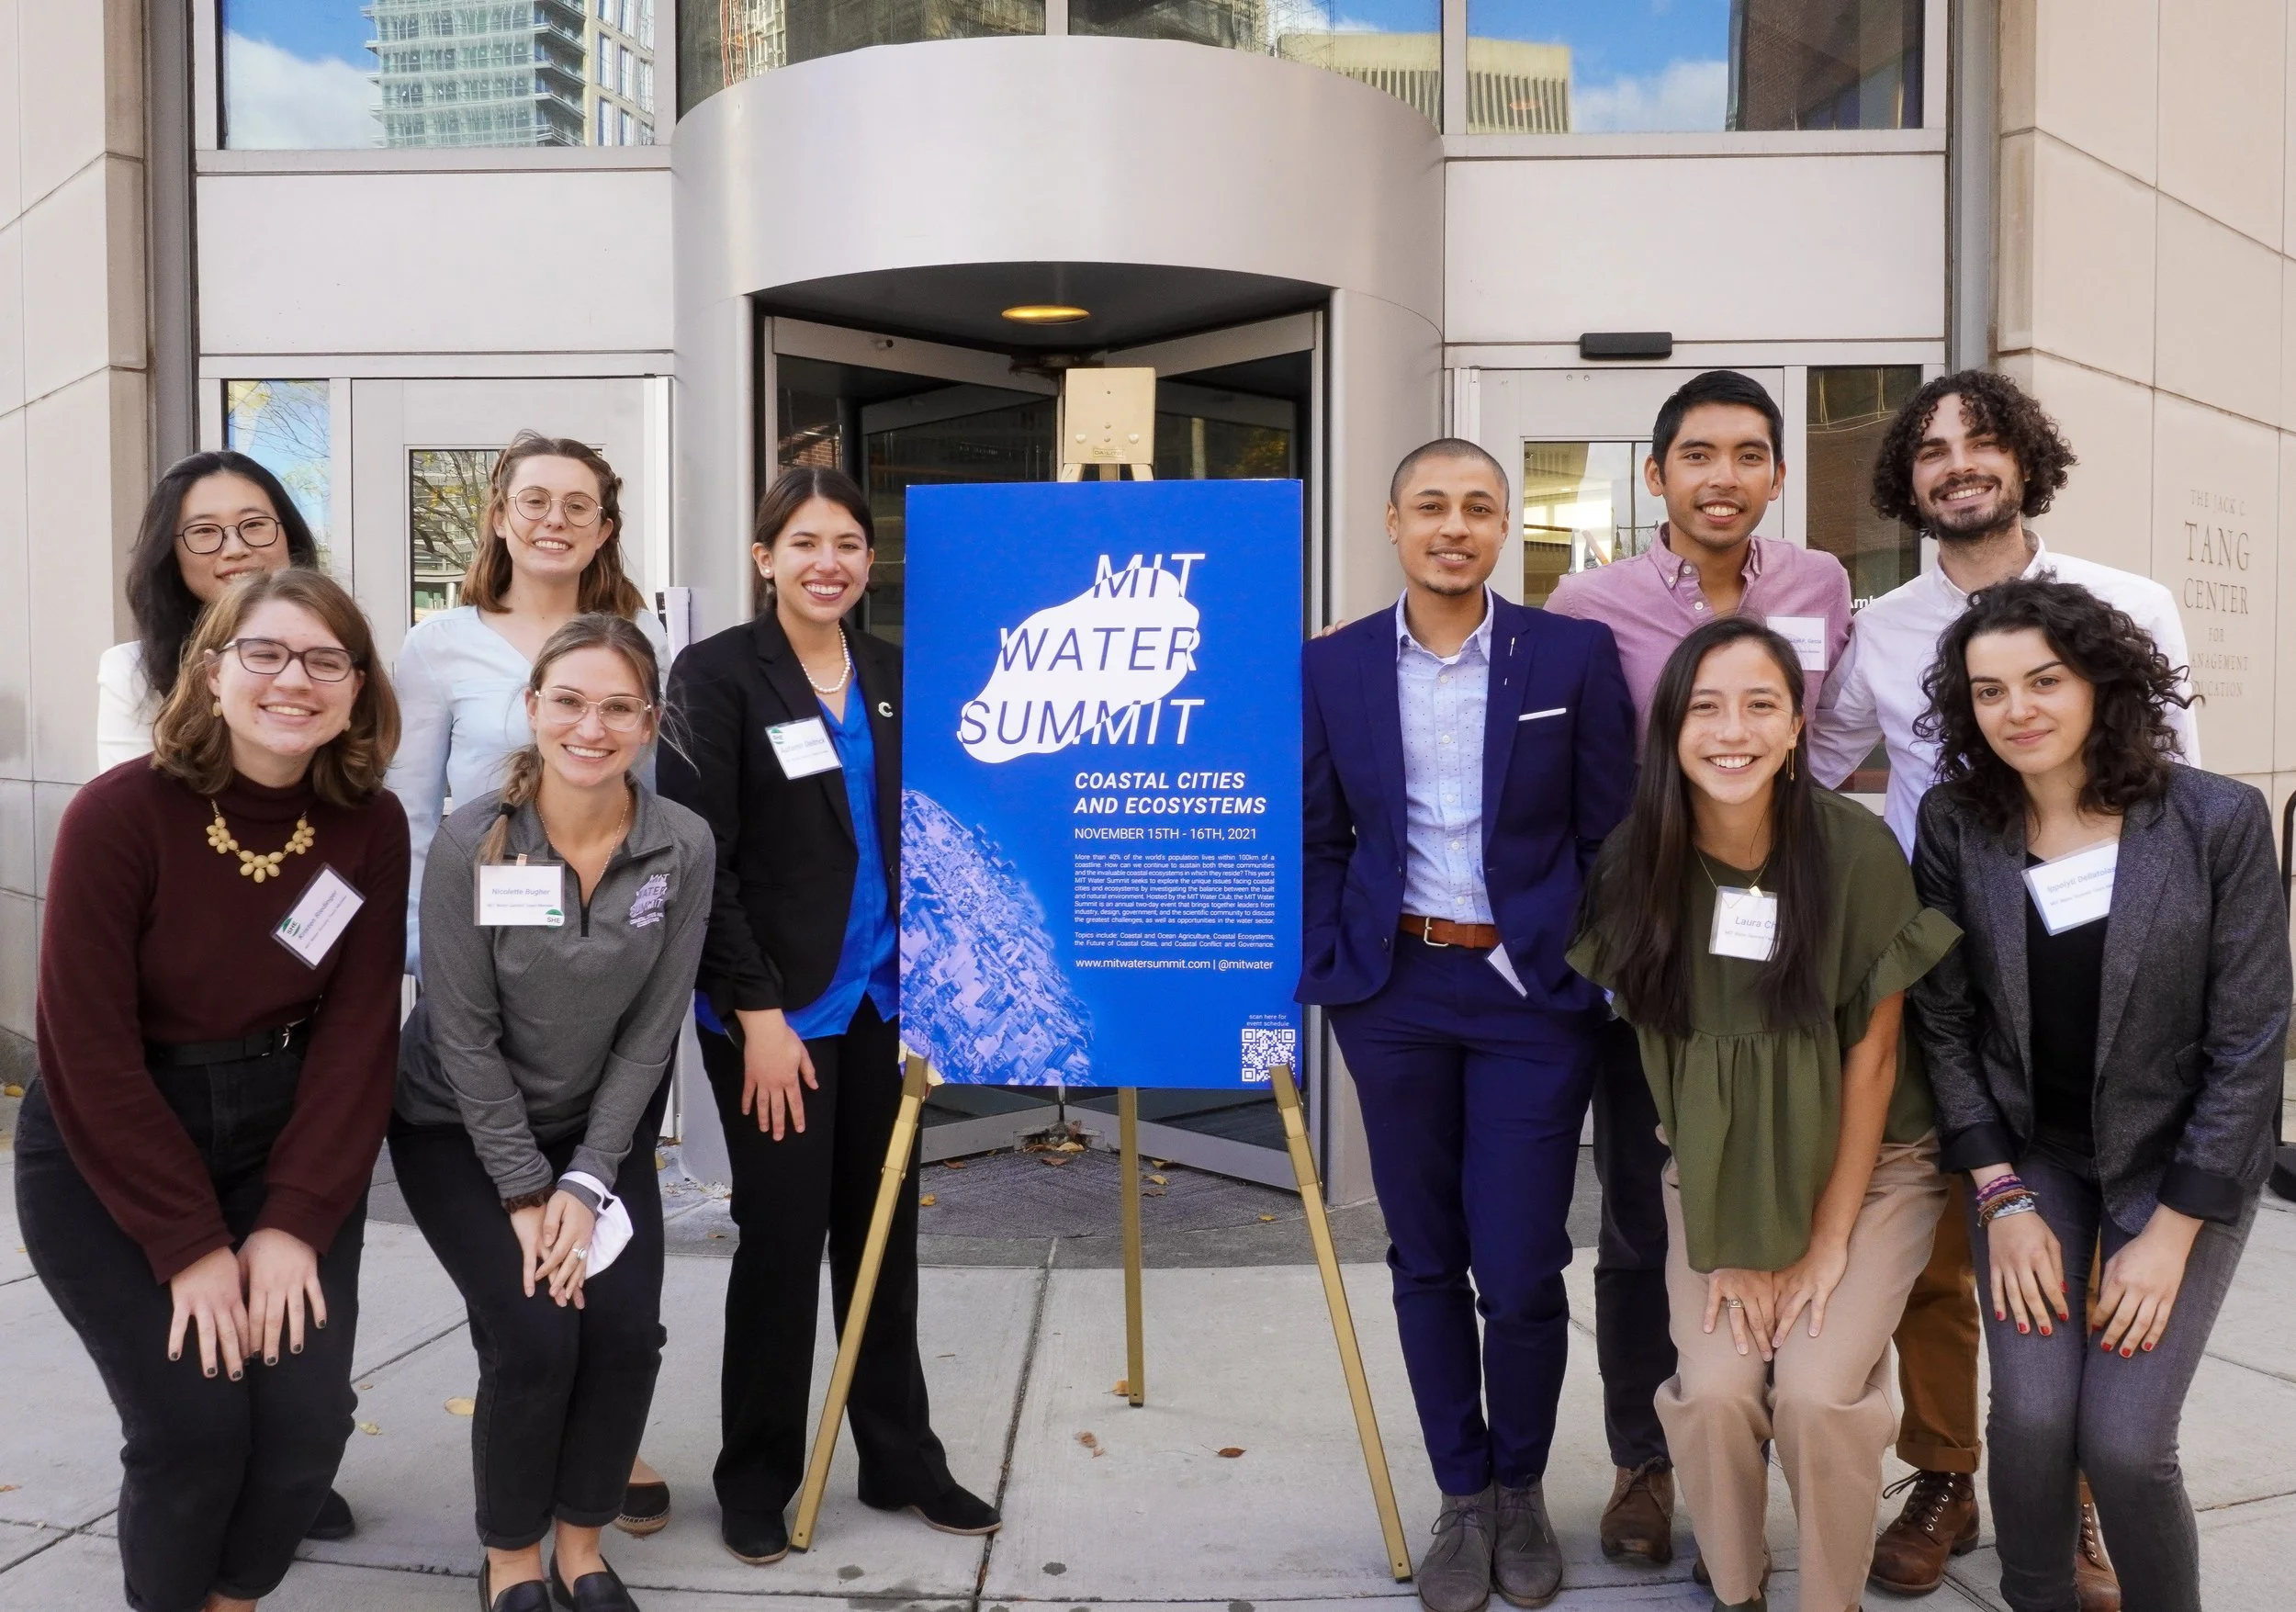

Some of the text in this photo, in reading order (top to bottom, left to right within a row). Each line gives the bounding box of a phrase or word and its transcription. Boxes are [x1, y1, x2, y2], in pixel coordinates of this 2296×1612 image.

[2190, 489, 2209, 508] THE
[2213, 493, 2236, 515] JACK
[2184, 520, 2250, 571] TANG
[1093, 553, 1206, 598] MIT
[2183, 577, 2249, 614] CENTER
[2208, 627, 2225, 643] FOR
[1000, 627, 1200, 671] WATER
[2190, 653, 2248, 671] ANAGEMENT
[957, 699, 1205, 745] SUMMIT
[1075, 772, 1246, 789] COASTAL CITIES
[1073, 797, 1266, 814] AND ECOSYSTEMS
[1075, 827, 1256, 841] NOVEMBER 15TH 16TH, 2021
[1233, 877, 1252, 886] facing
[1735, 916, 1761, 927] Laura
[1074, 932, 1095, 941] Topics
[1075, 958, 1274, 972] www.mitwatersummit.com @mitwater
